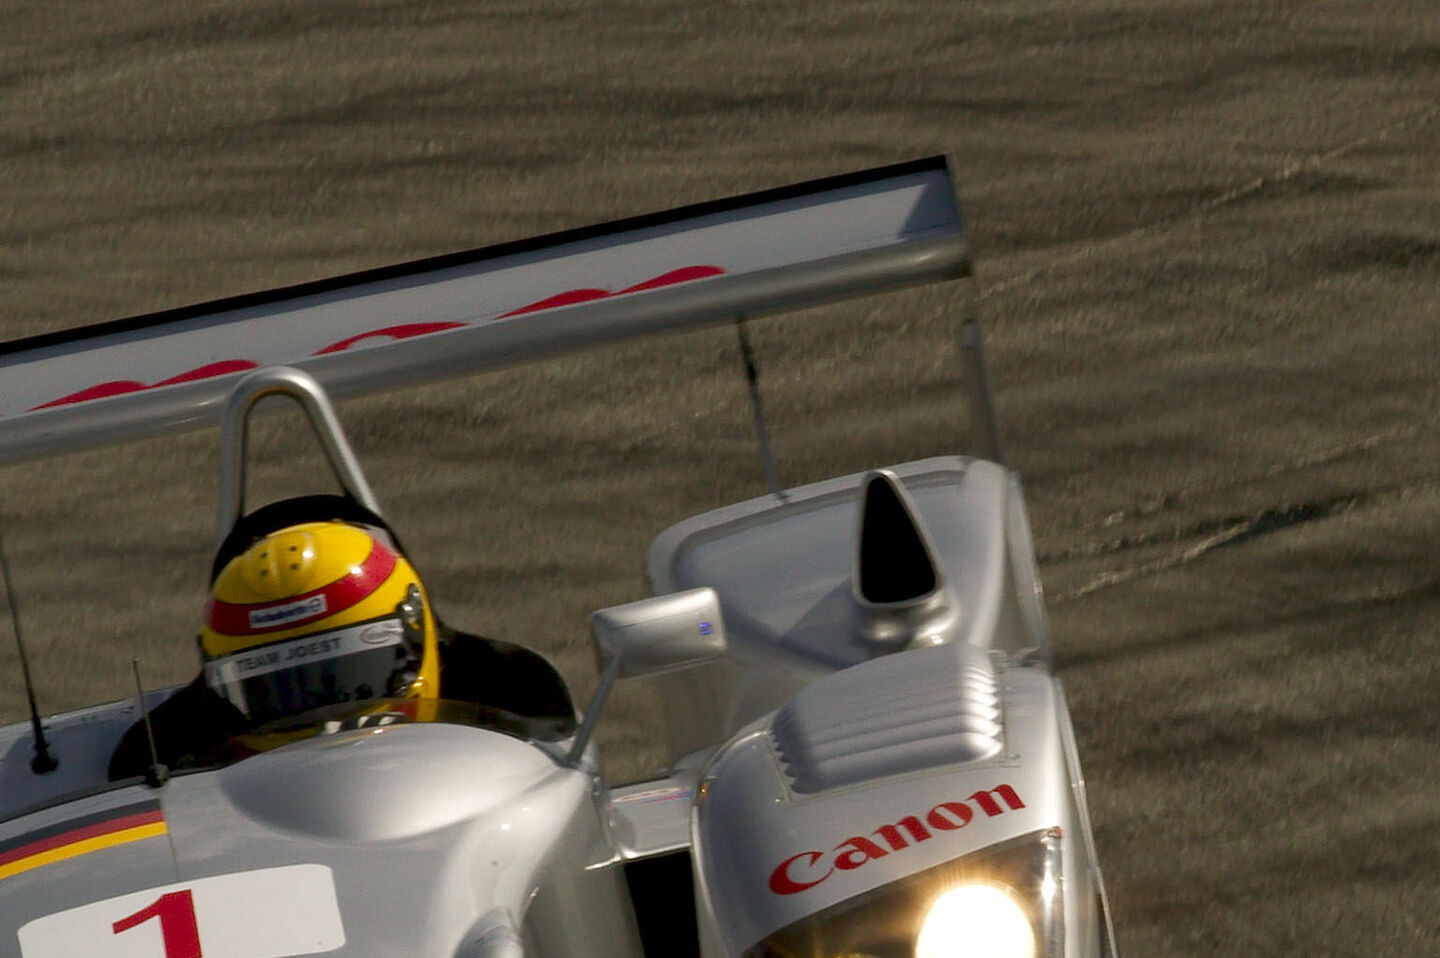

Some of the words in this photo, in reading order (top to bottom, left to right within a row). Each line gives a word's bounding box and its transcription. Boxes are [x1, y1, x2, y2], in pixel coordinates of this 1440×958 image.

[236, 652, 280, 670] TEAM
[286, 636, 342, 661] JOEST
[768, 783, 1026, 895] Canon
